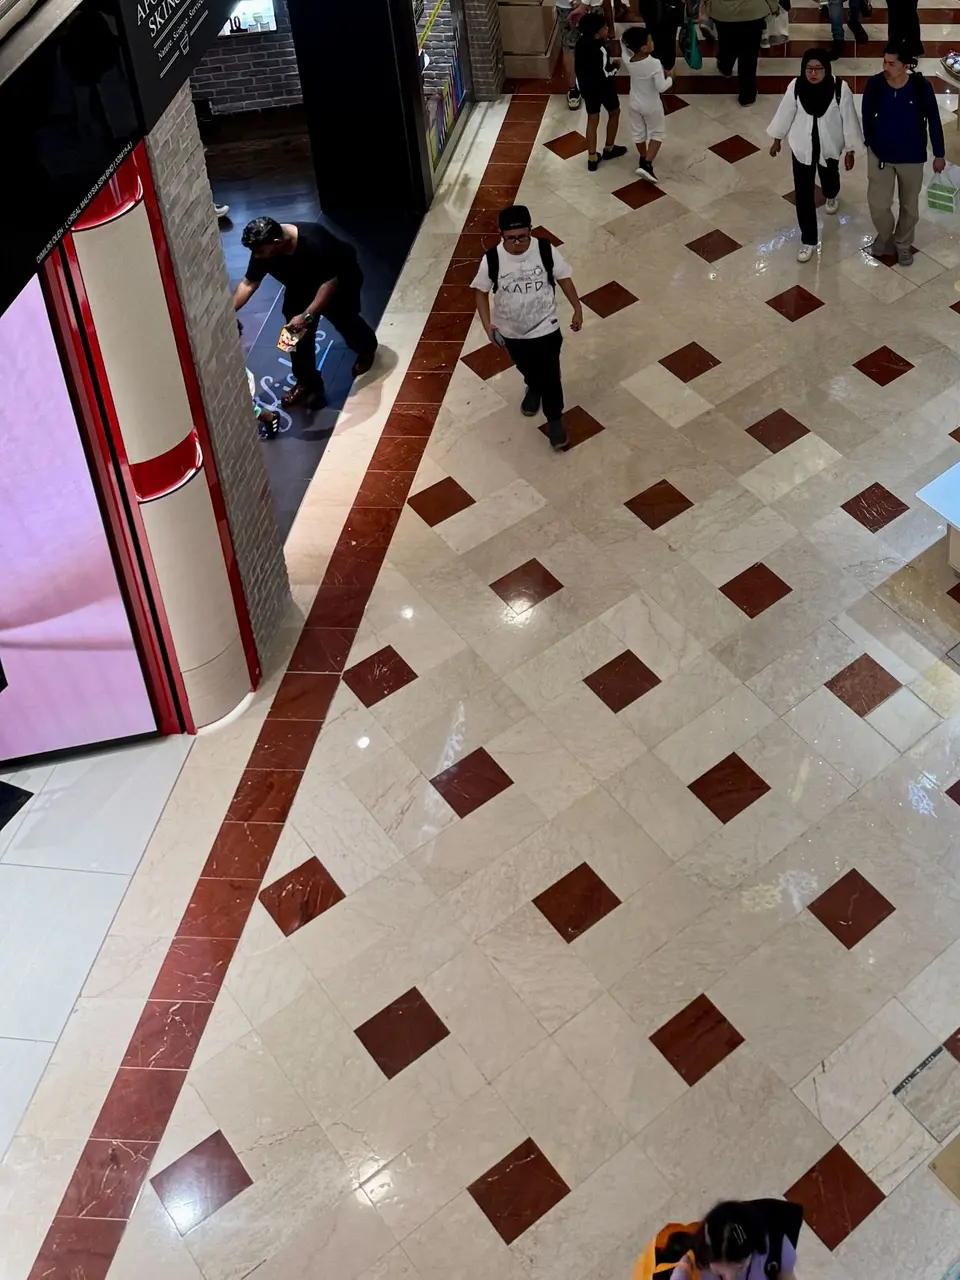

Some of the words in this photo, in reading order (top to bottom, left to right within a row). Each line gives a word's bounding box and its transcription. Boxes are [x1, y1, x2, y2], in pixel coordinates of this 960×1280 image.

[157, 39, 174, 61] Nature.
[80, 183, 99, 208] MALAYSIA
[501, 280, 544, 294] KAFD
